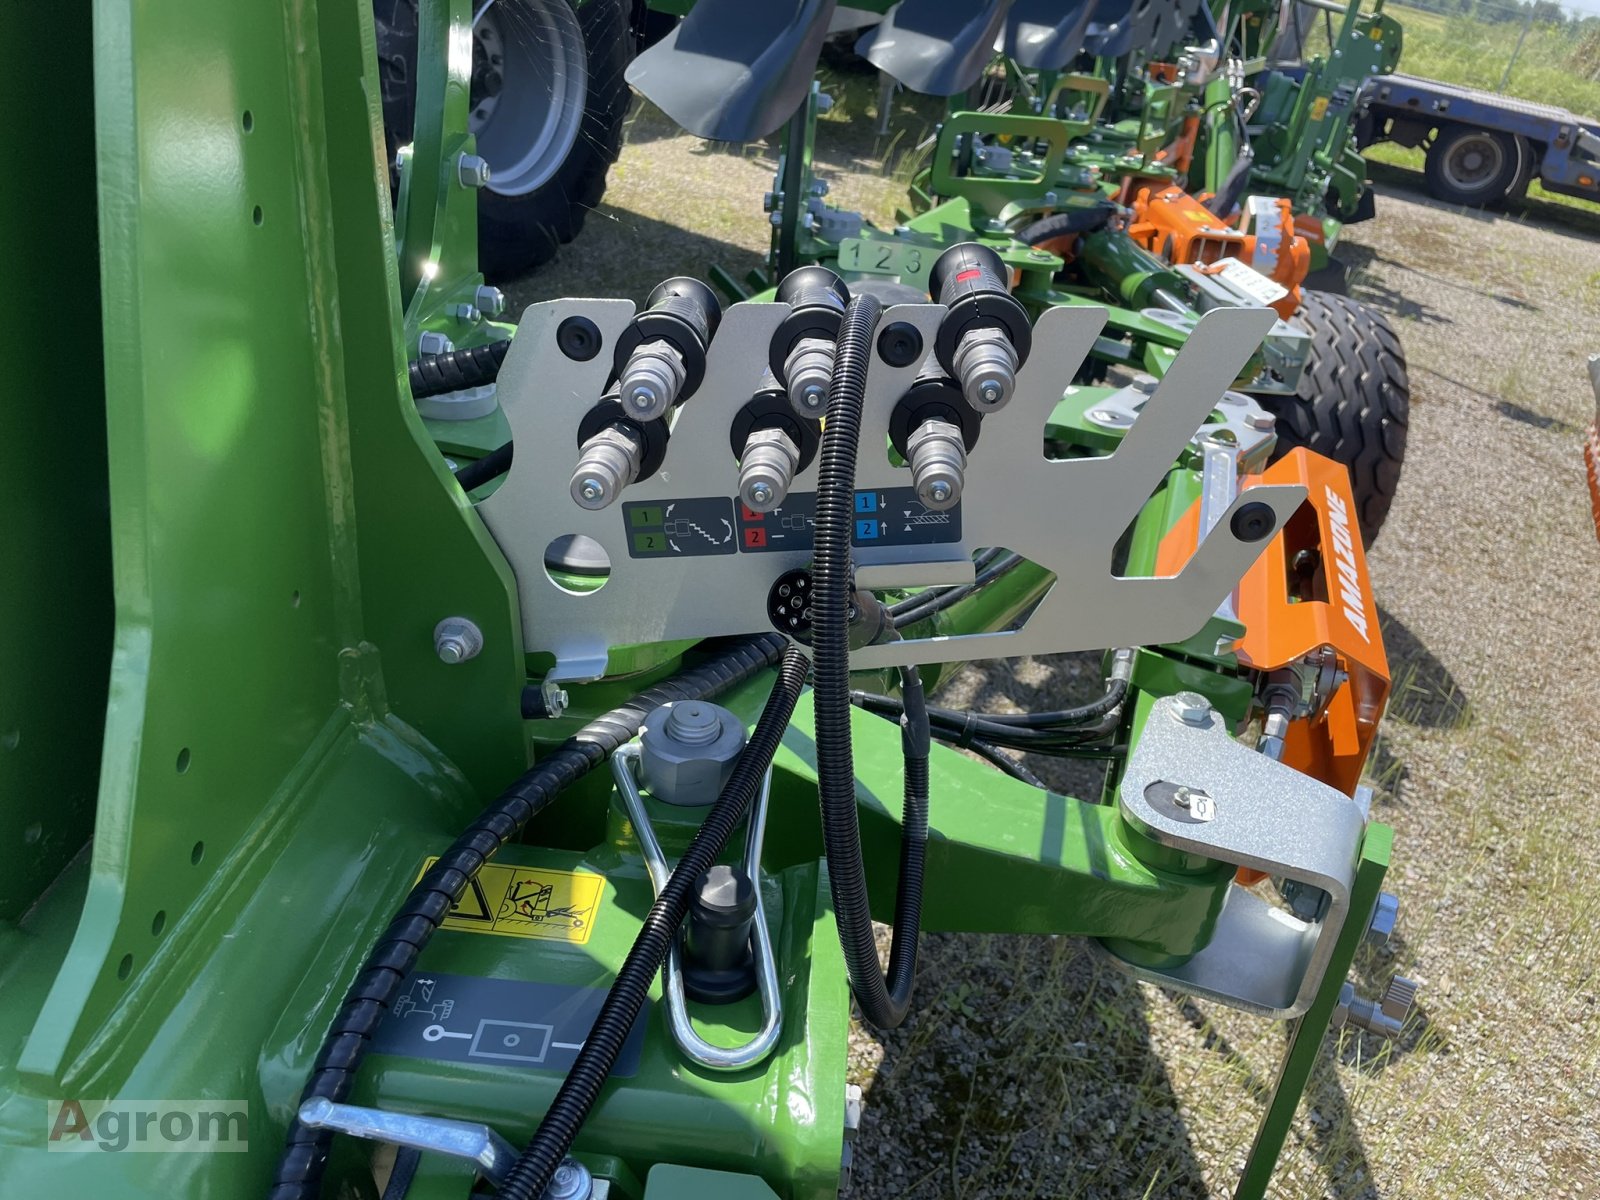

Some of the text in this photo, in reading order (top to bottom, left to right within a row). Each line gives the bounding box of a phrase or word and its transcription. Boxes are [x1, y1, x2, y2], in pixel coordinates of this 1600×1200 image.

[850, 243, 922, 274] 1 2 3
[862, 496, 870, 509] 1
[642, 511, 648, 522] 1
[863, 522, 871, 535] 2
[646, 536, 654, 548] 2
[752, 531, 760, 543] 2
[1325, 484, 1371, 644] AMAZONE
